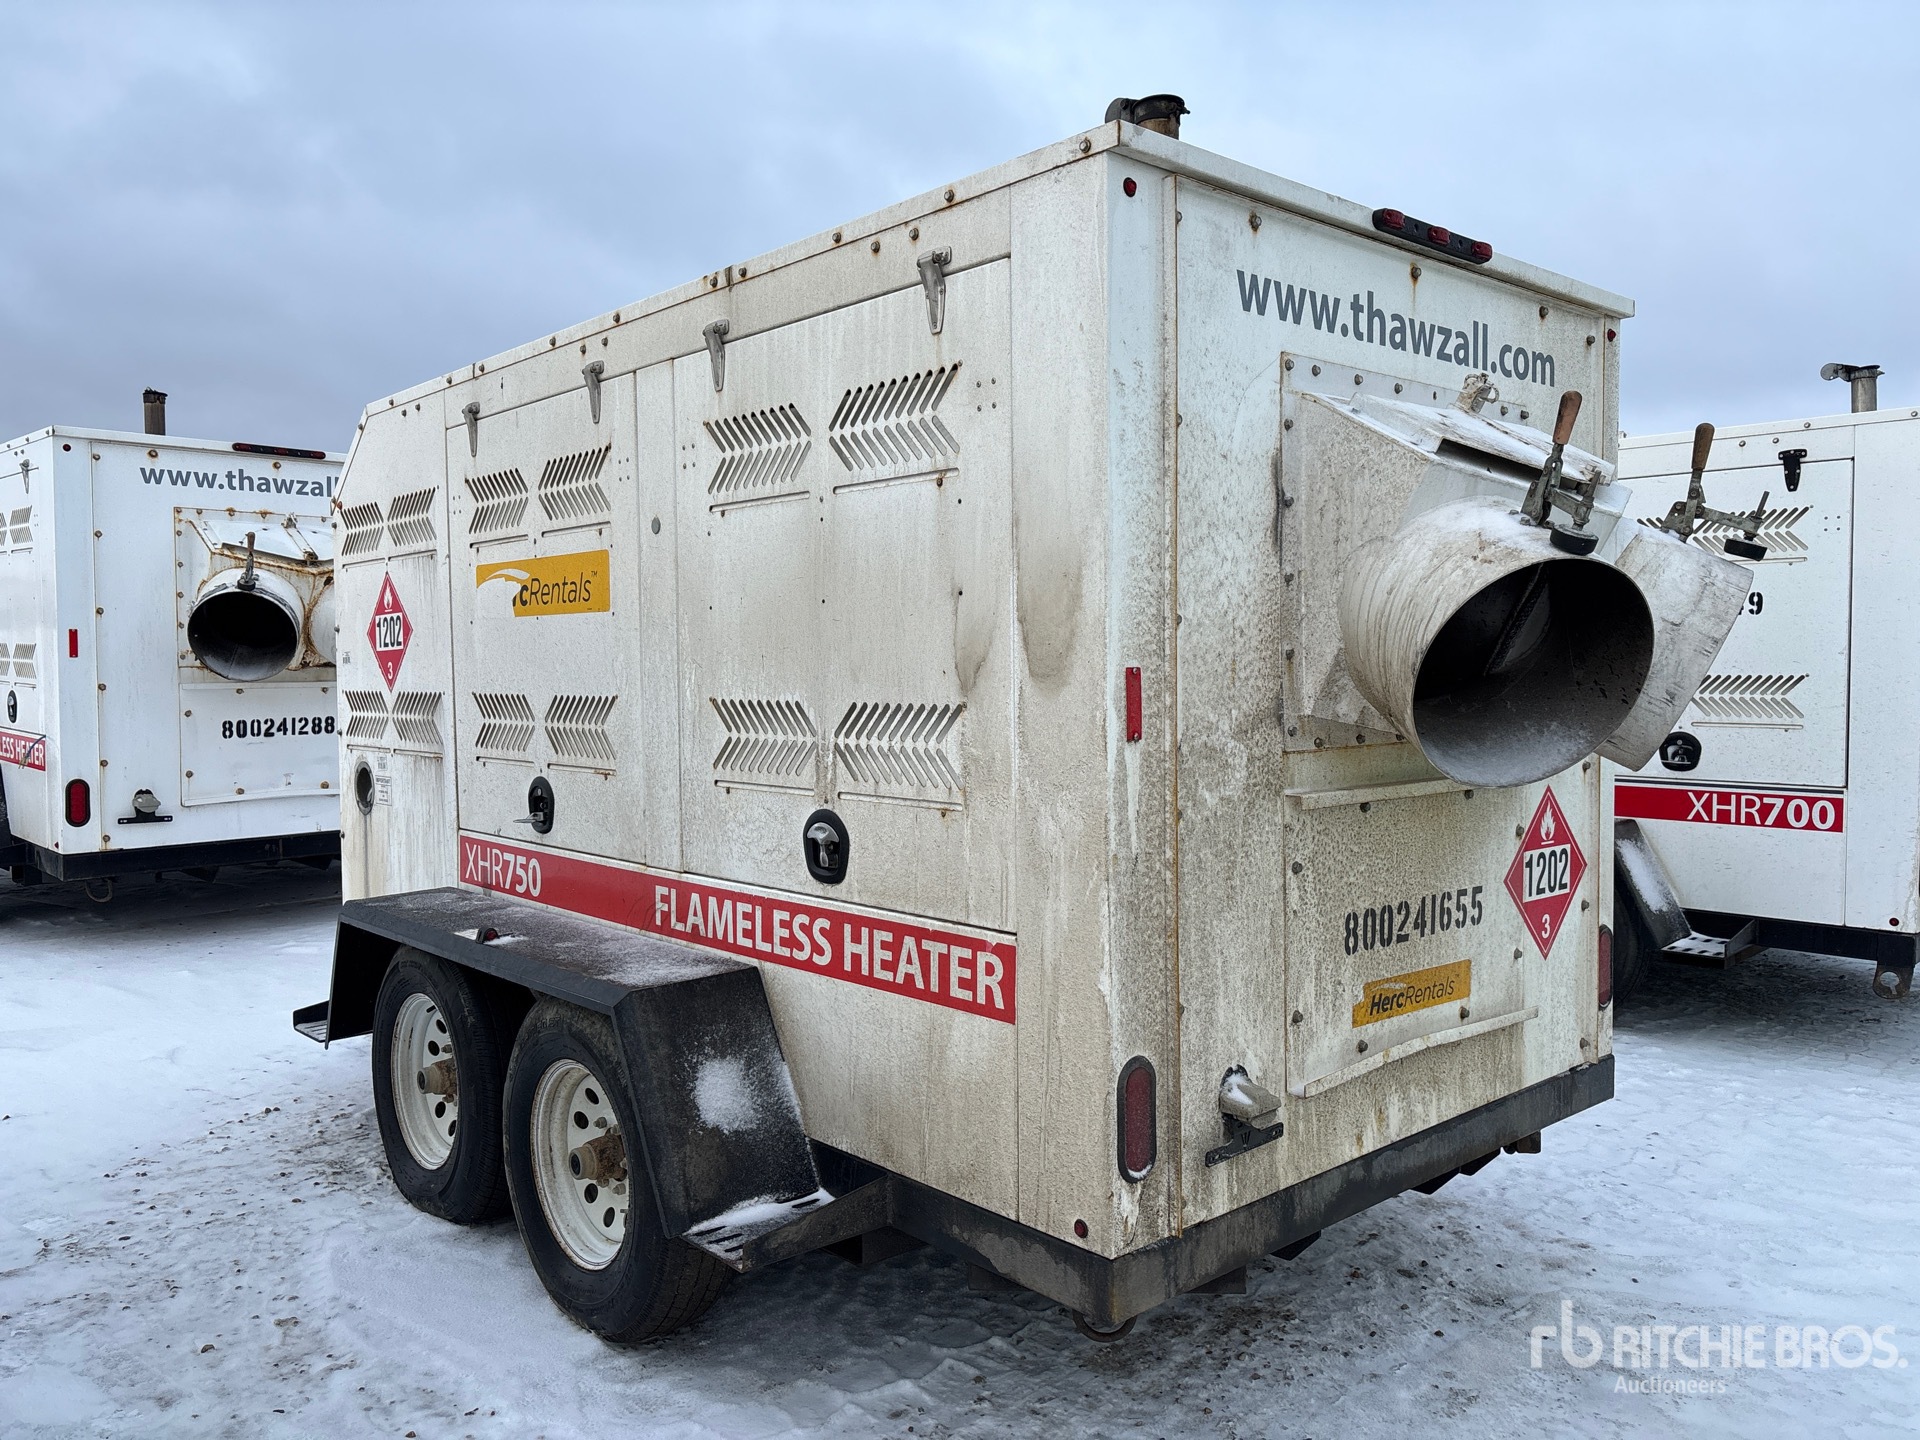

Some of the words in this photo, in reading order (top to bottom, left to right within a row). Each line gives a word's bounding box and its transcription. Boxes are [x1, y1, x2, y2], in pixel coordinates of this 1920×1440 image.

[1236, 269, 1556, 388] www.thawzall.com
[376, 615, 403, 649] 1202
[387, 661, 394, 680] 3
[221, 716, 336, 739] 800241288
[1686, 791, 1836, 831] XHR700
[464, 841, 542, 897] XHR750
[1524, 848, 1570, 898] 1202
[1344, 885, 1484, 956] 800241655
[1541, 913, 1551, 939] 3
[654, 885, 832, 967] FLAMELESS
[843, 923, 1006, 1011] HEATER
[1369, 975, 1456, 1016] HercRentals
